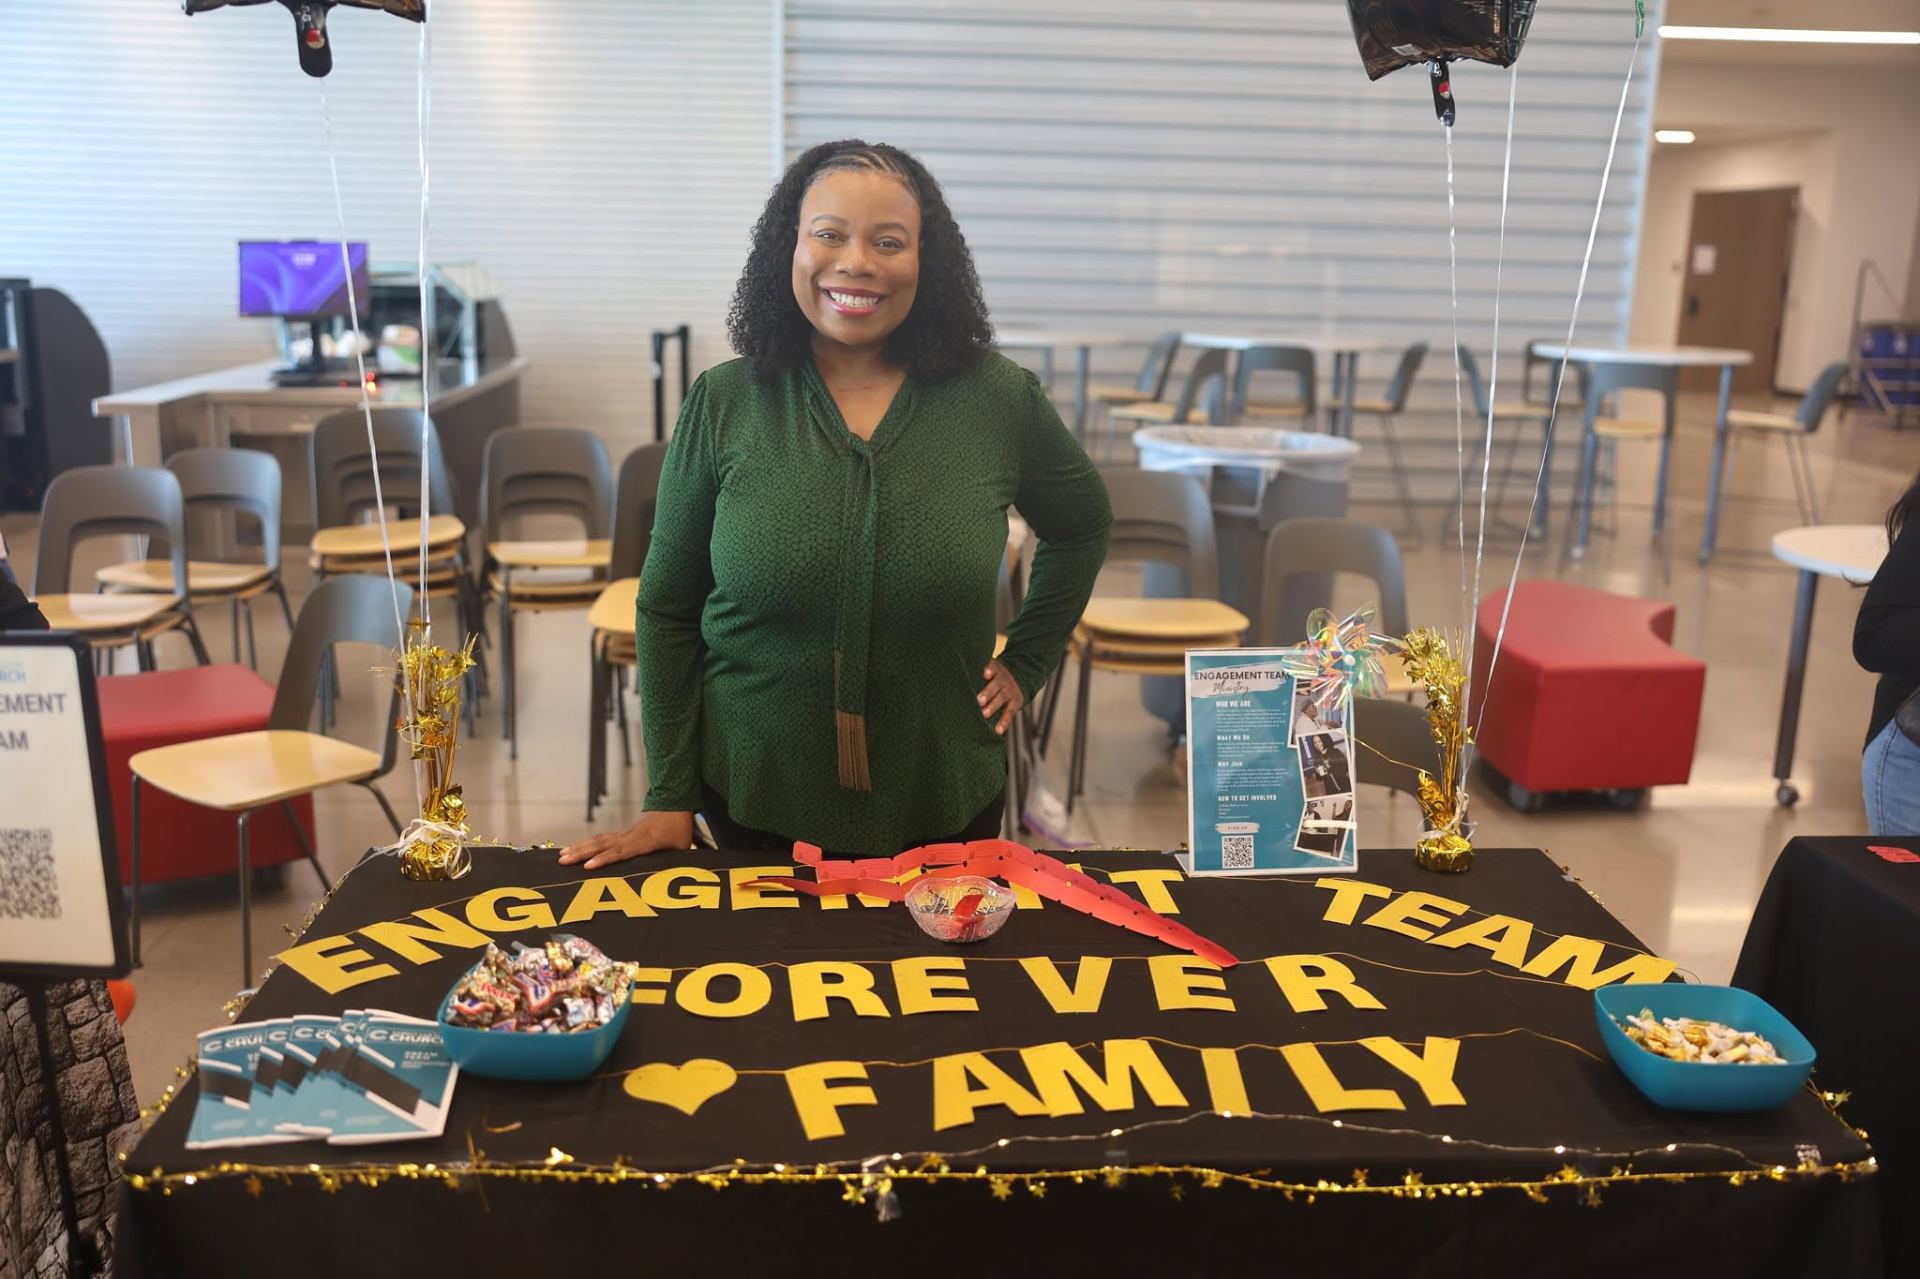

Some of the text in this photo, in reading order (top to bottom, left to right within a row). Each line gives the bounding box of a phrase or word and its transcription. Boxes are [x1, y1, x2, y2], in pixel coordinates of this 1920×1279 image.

[1194, 670, 1289, 680] ENGAGEMENT TEAM
[1229, 700, 1239, 708] WE
[1240, 700, 1251, 708] ARE
[276, 863, 1678, 994] ENGAGET TEAM
[784, 1036, 1466, 1141] FAMILY
